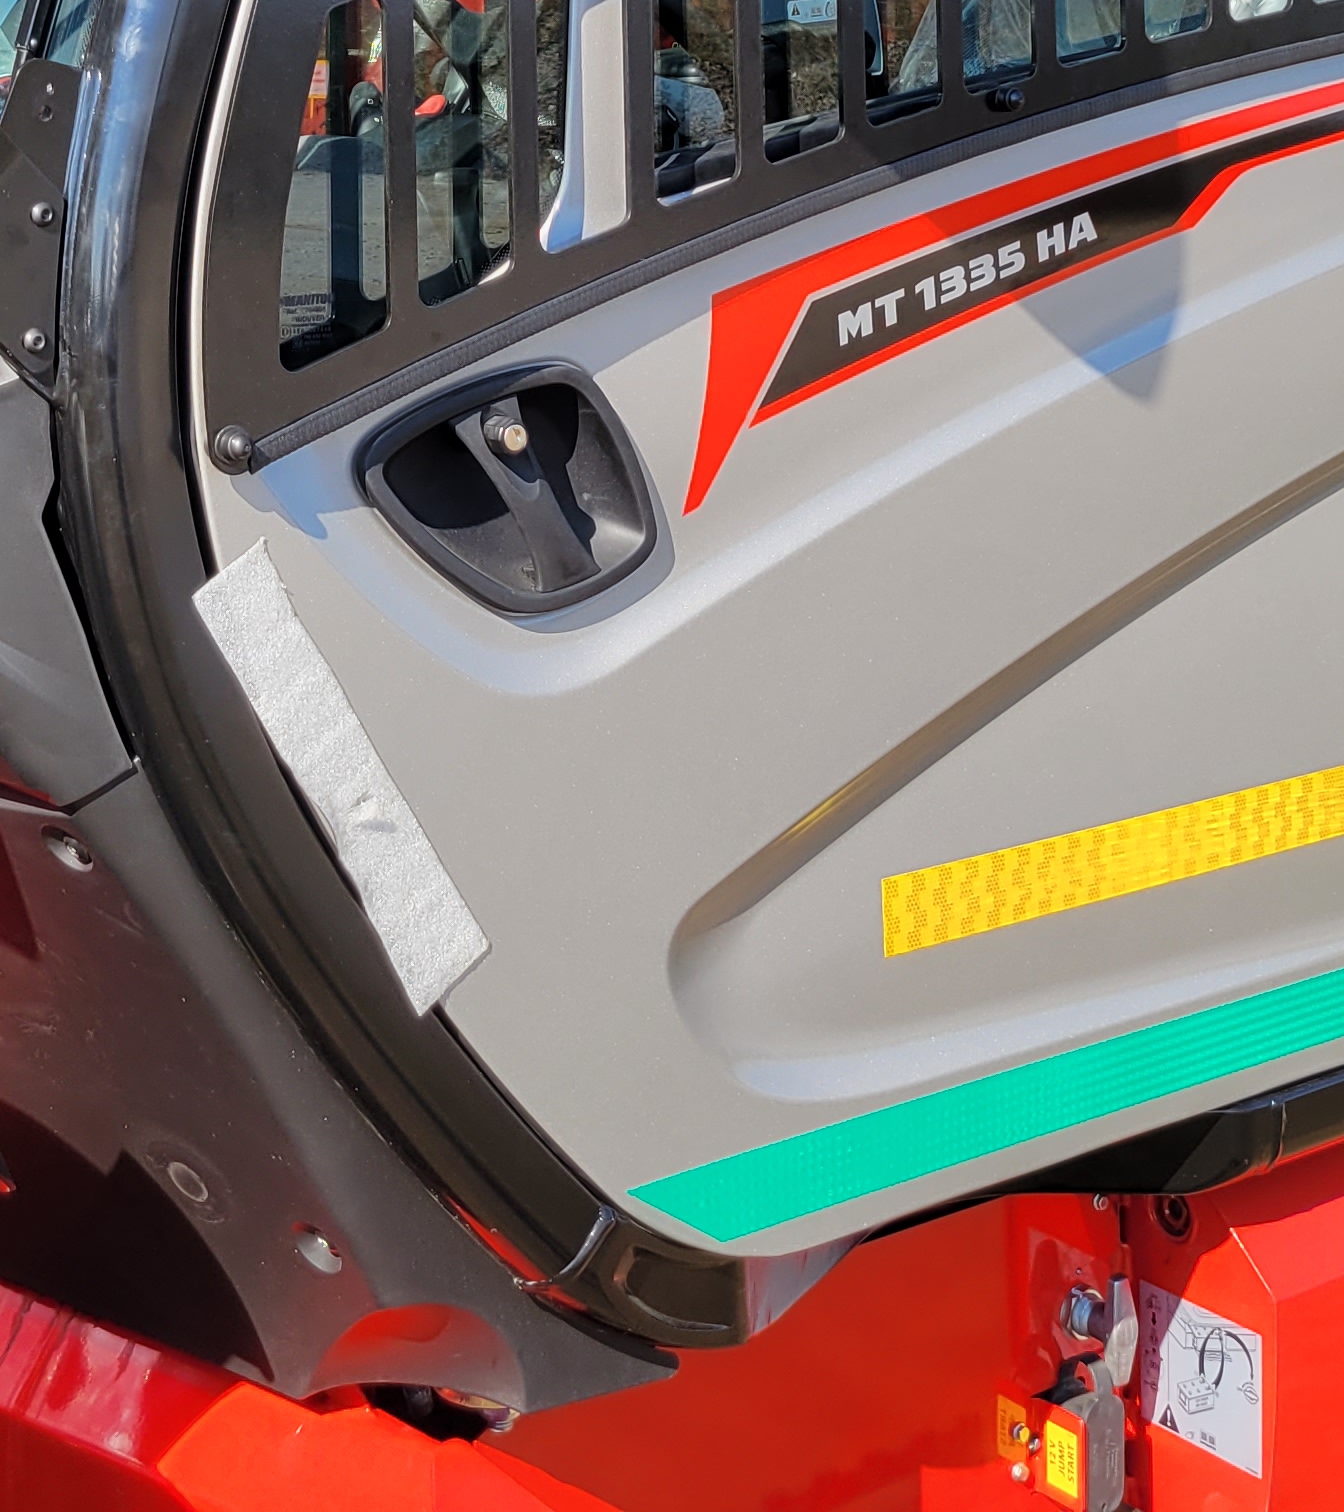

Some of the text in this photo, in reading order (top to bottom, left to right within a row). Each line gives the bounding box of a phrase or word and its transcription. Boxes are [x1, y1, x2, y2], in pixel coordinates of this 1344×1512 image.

[837, 211, 1098, 347] MT 1335 HA
[1049, 1439, 1057, 1465] 12 V
[1058, 1440, 1067, 1478] JUMP
[1067, 1444, 1075, 1484] START
